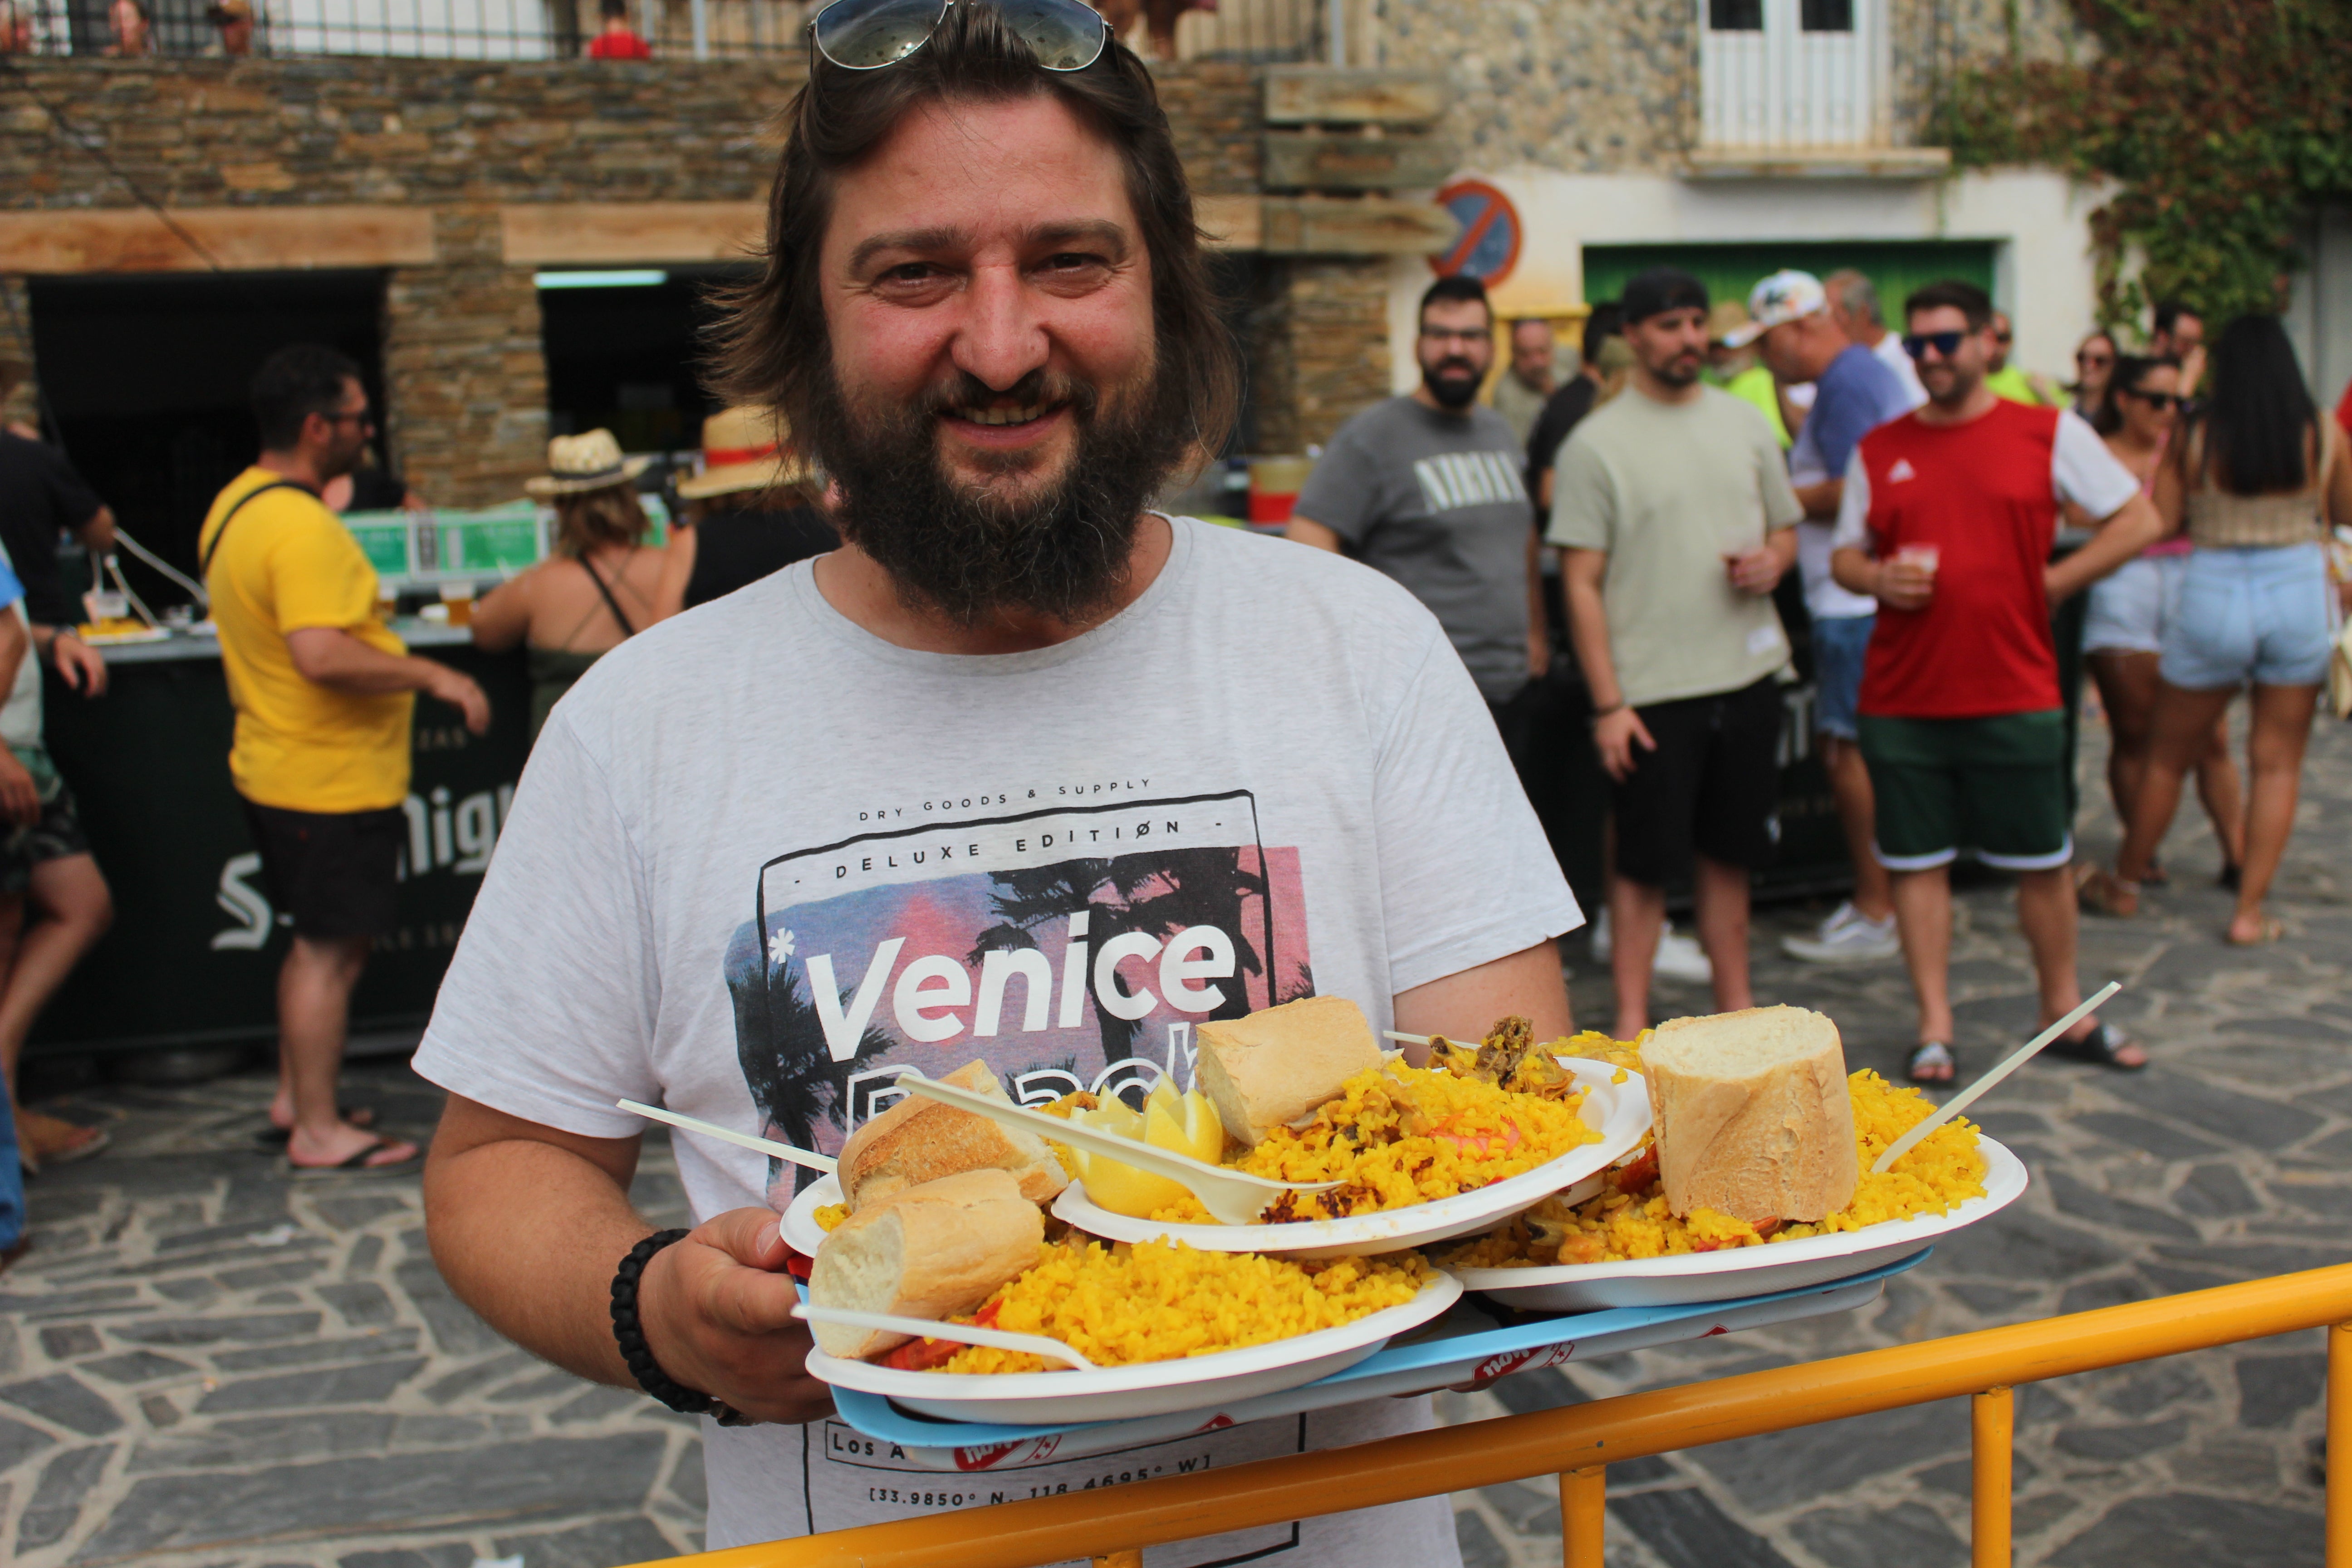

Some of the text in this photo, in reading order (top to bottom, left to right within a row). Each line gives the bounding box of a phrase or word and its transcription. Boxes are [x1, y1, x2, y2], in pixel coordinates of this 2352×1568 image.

[860, 779, 1149, 821] DRY GOODS & SUPPLY
[836, 843, 979, 879] DELUXE
[805, 910, 1236, 1063] Venice
[833, 1433, 874, 1456] LOS
